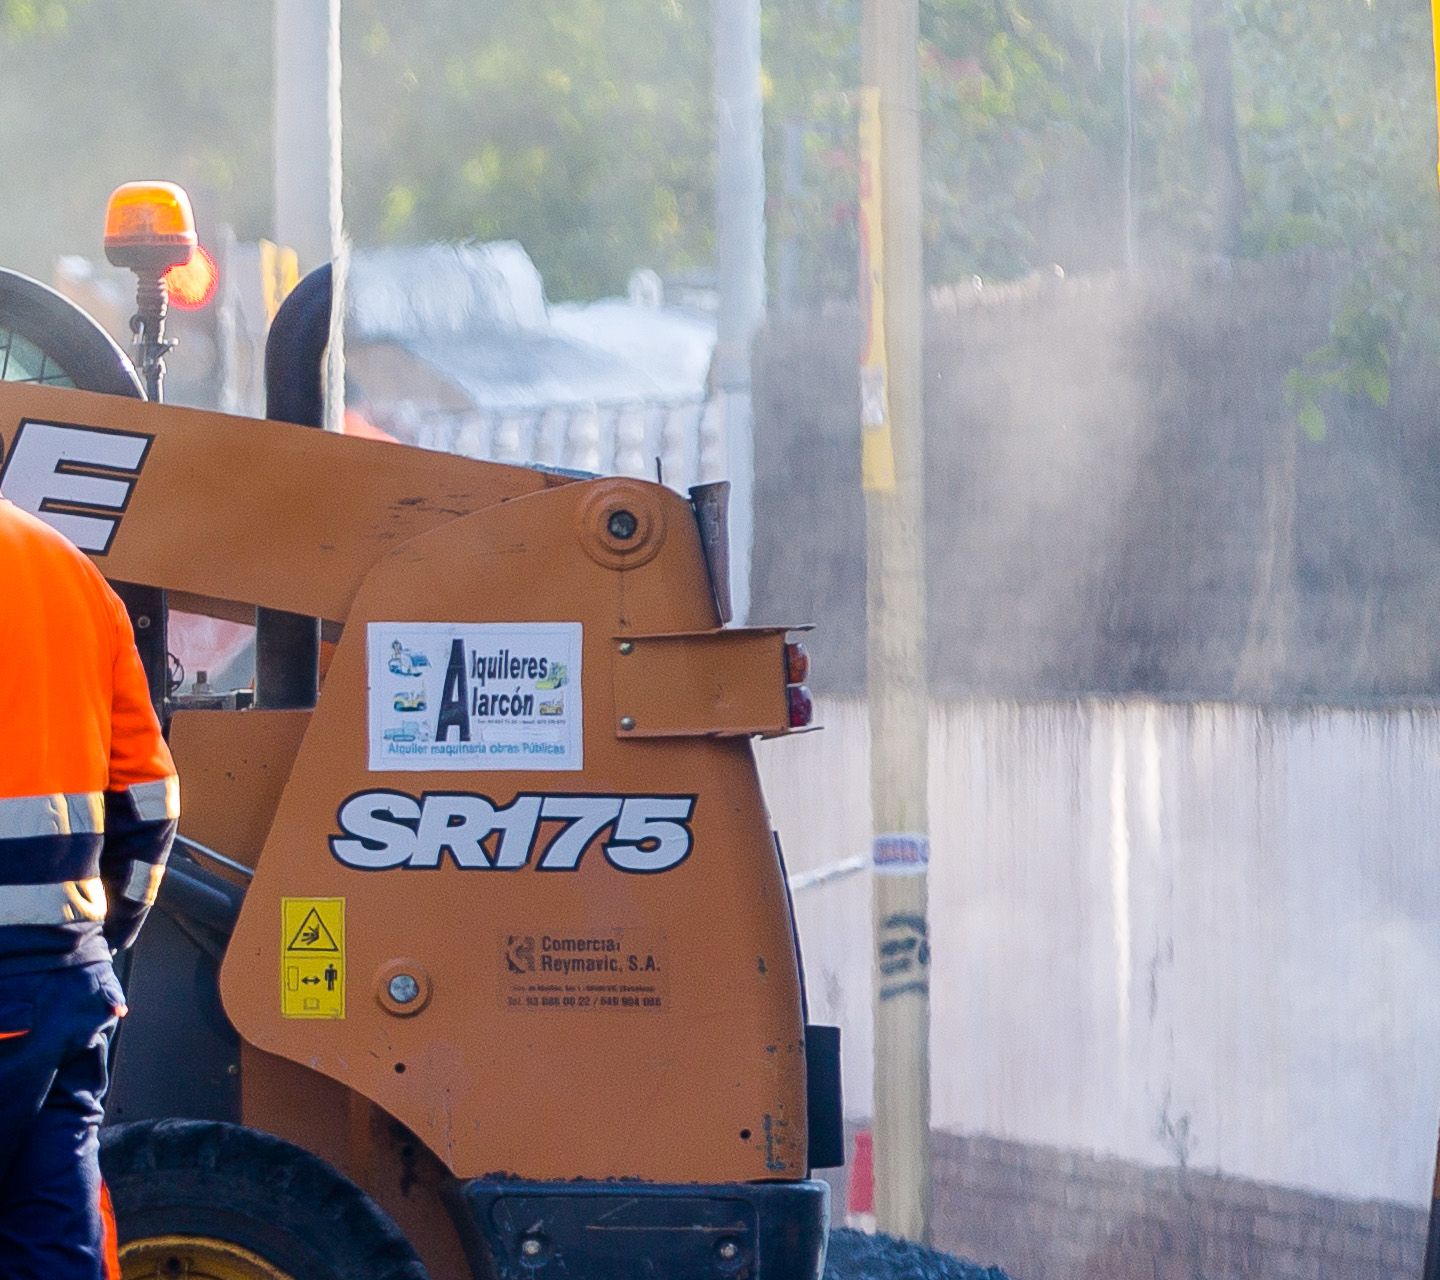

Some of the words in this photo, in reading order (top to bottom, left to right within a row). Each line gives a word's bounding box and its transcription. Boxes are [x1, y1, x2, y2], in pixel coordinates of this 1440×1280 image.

[388, 741, 428, 756] Alquiler
[430, 741, 487, 757] maquinaria
[489, 741, 520, 755] obras
[522, 740, 566, 755] Públicas
[328, 787, 699, 874] SR175
[628, 955, 661, 972] S.A.
